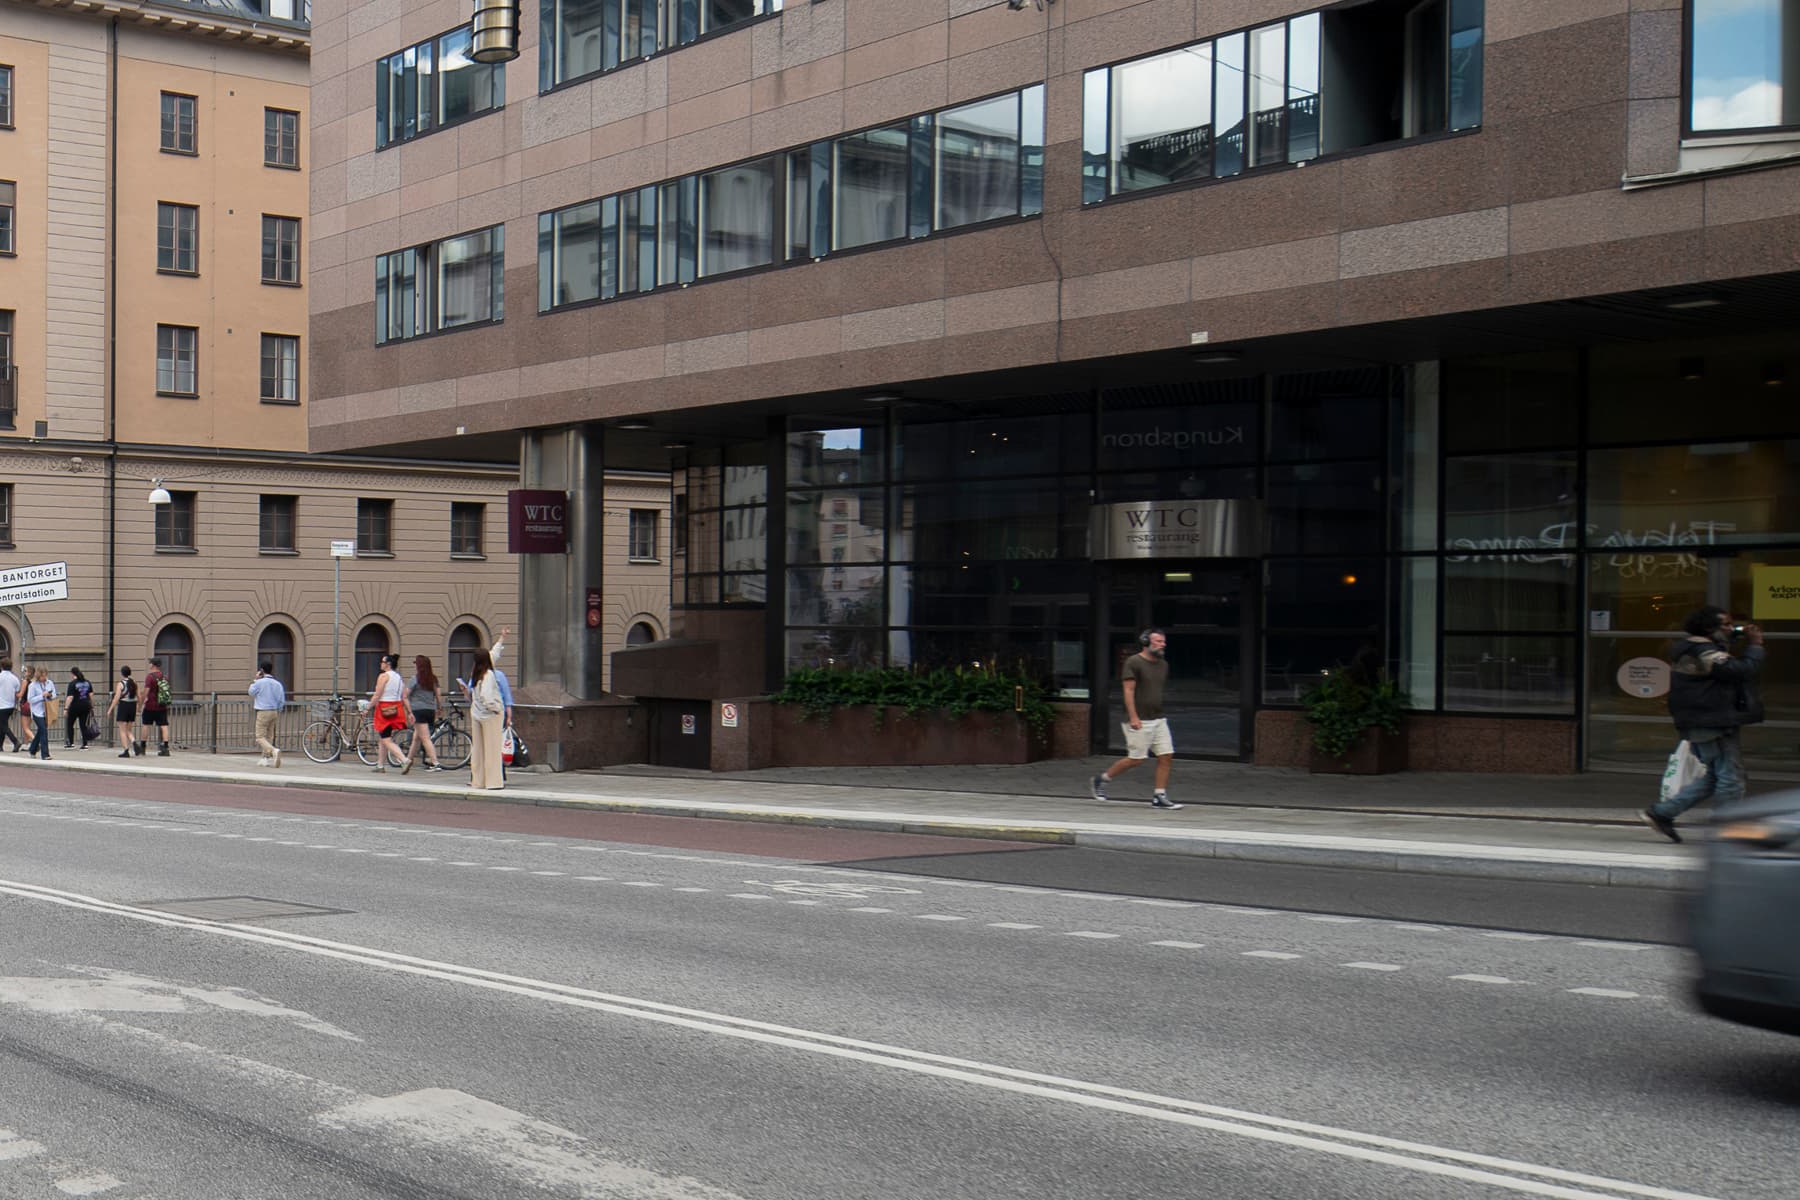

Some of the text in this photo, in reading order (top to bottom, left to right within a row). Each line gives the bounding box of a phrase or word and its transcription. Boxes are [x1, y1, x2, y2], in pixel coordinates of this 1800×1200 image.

[524, 505, 562, 520] WTC
[1126, 508, 1198, 528] WTC
[1126, 533, 1201, 544] restaurang
[3, 567, 64, 583] BANTORGET
